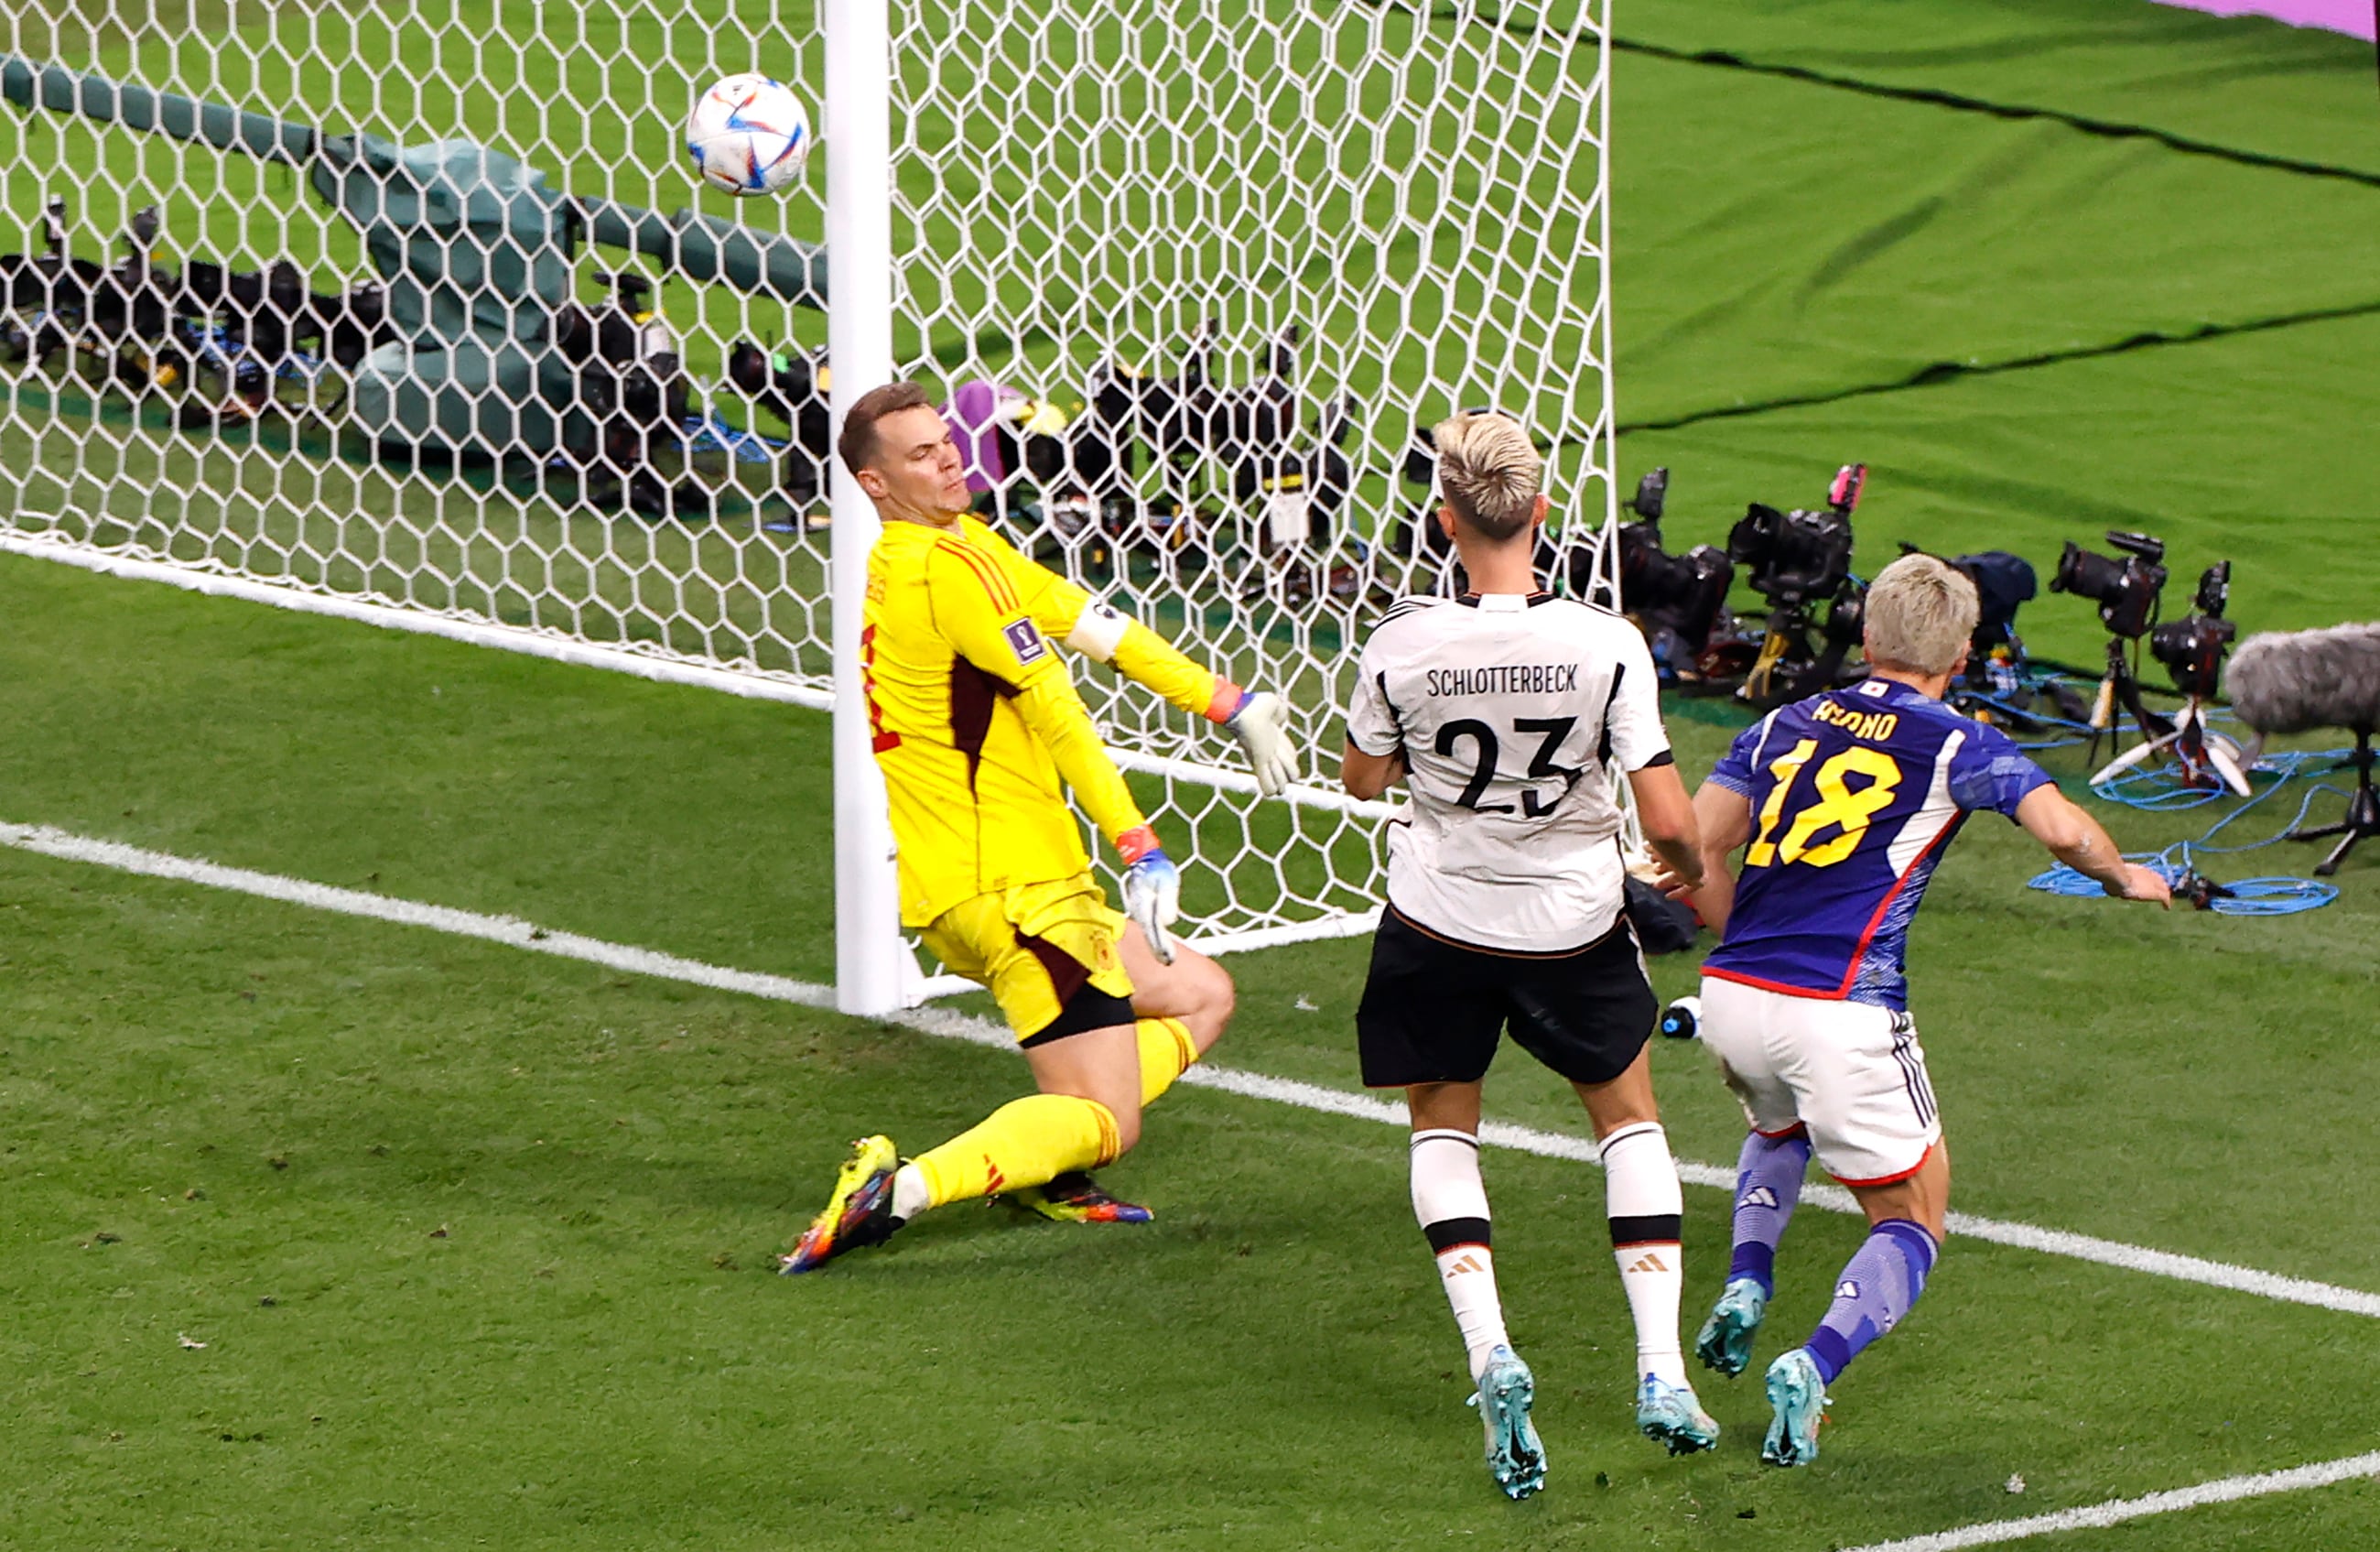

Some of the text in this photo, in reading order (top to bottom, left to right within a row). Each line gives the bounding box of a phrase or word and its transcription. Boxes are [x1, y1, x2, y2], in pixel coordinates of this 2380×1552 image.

[1427, 664, 1578, 697] SCHLOTTERBECK
[1434, 716, 1584, 819] 23
[1745, 739, 1903, 867] 18
